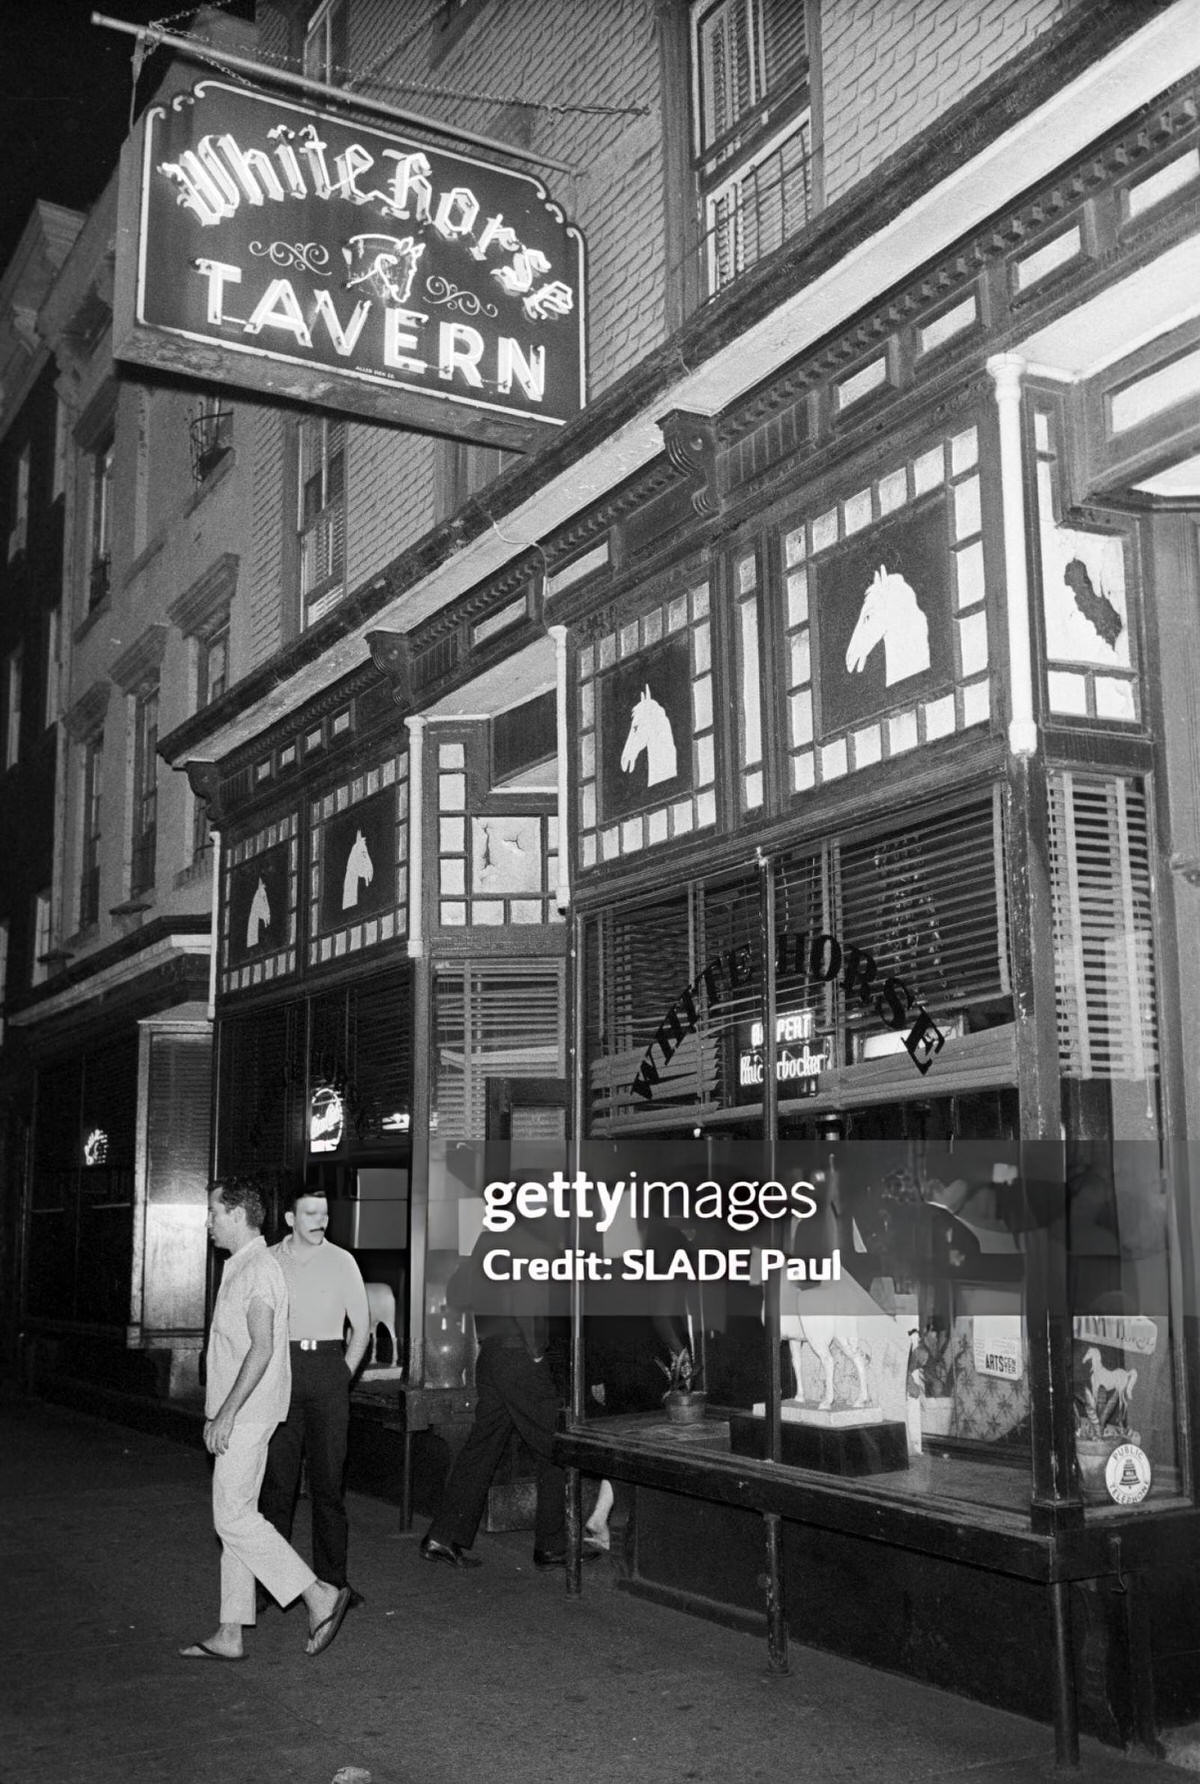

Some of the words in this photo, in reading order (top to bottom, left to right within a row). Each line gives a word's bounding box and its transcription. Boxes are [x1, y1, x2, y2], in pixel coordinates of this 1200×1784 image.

[157, 125, 374, 226] White
[382, 149, 574, 320] Horse
[196, 257, 546, 402] TAVERN
[630, 942, 752, 1099] WHITE
[775, 934, 945, 1075] HORSE
[985, 1353, 1004, 1372] ARTS
[1110, 1481, 1149, 1504] TELEPHONE
[1112, 1446, 1144, 1460] PUBLIC
